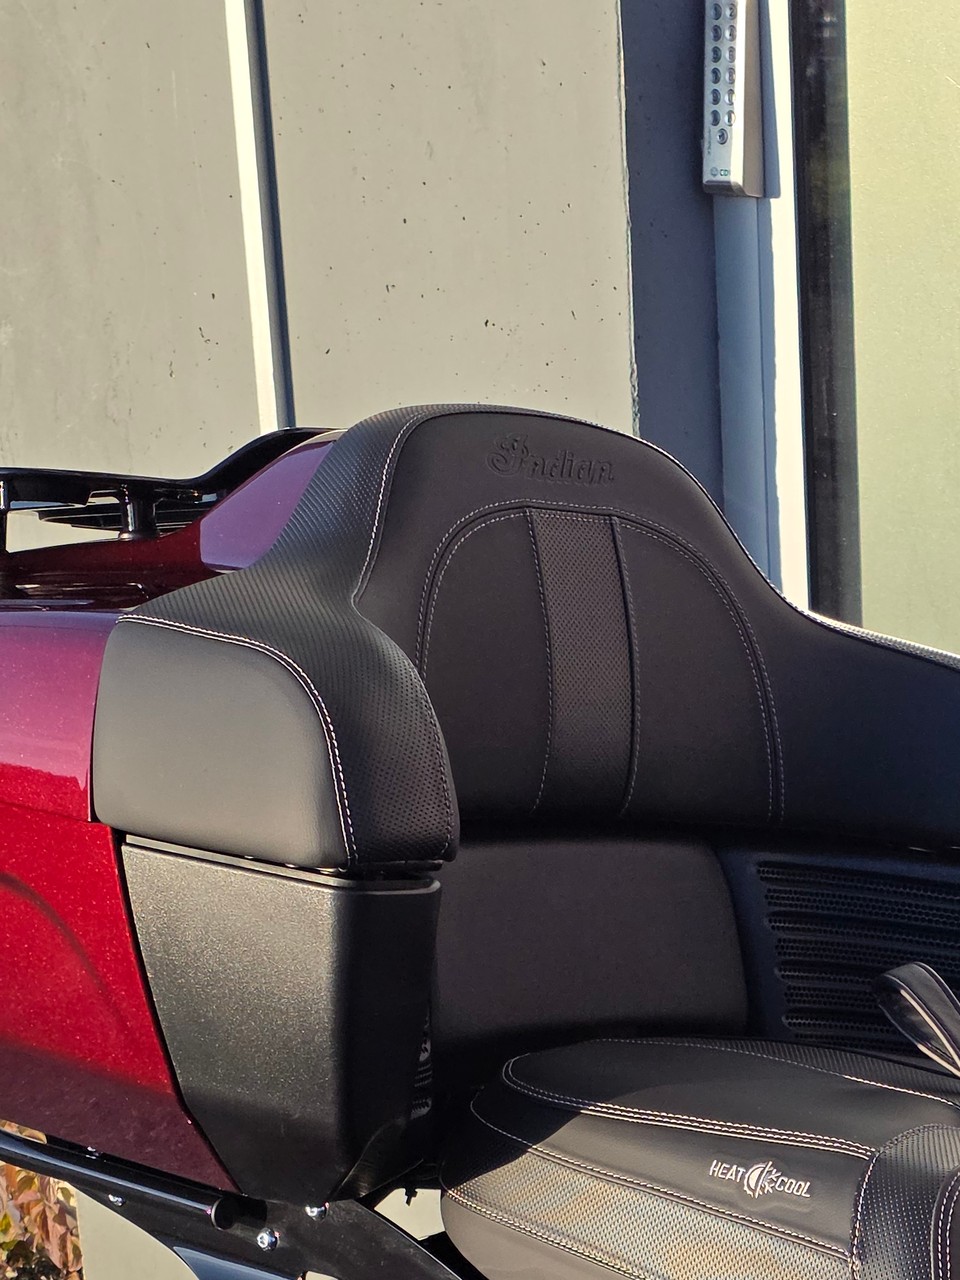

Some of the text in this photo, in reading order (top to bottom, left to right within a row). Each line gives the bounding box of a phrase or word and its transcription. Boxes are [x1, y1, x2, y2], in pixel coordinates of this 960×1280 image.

[486, 433, 615, 487] Indian
[709, 1159, 811, 1198] HEAT COOL
